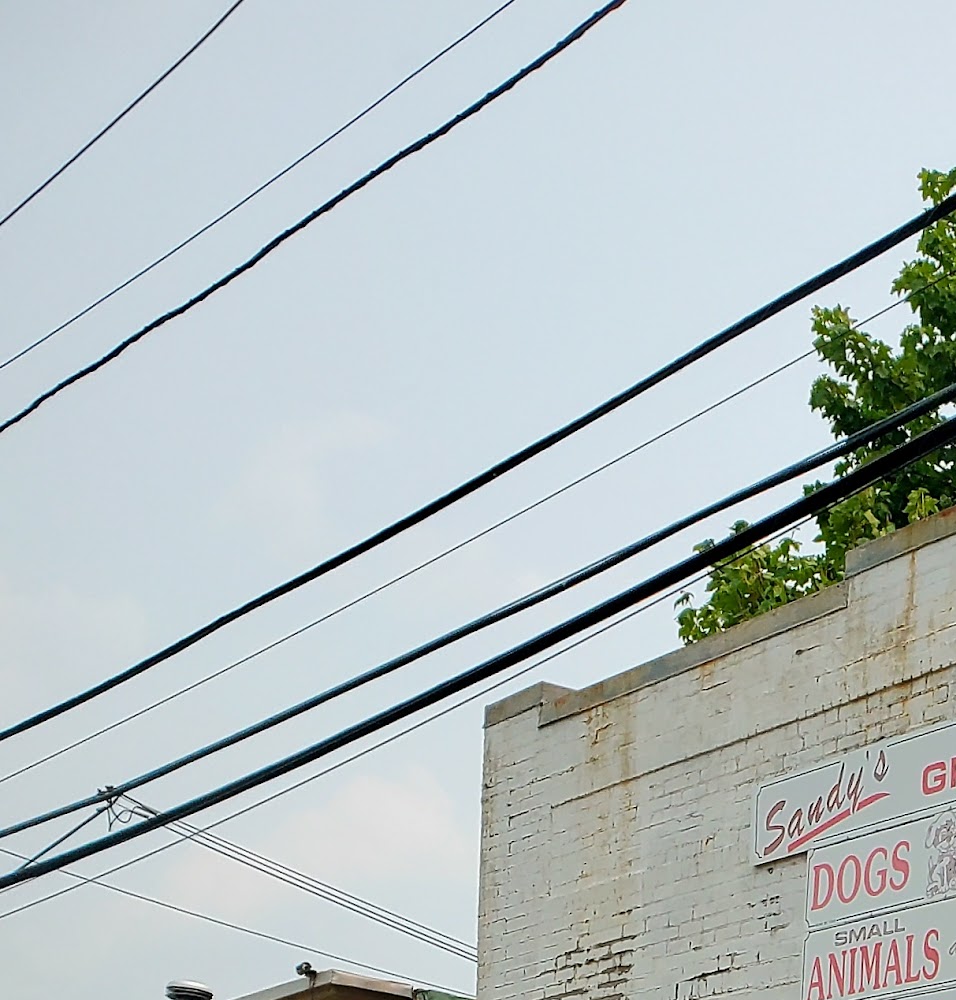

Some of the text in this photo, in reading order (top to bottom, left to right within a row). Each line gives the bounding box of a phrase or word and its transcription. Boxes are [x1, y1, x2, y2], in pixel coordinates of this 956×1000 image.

[763, 750, 890, 856] Sandy's
[811, 841, 910, 911] DOGS
[834, 918, 906, 947] SMALL
